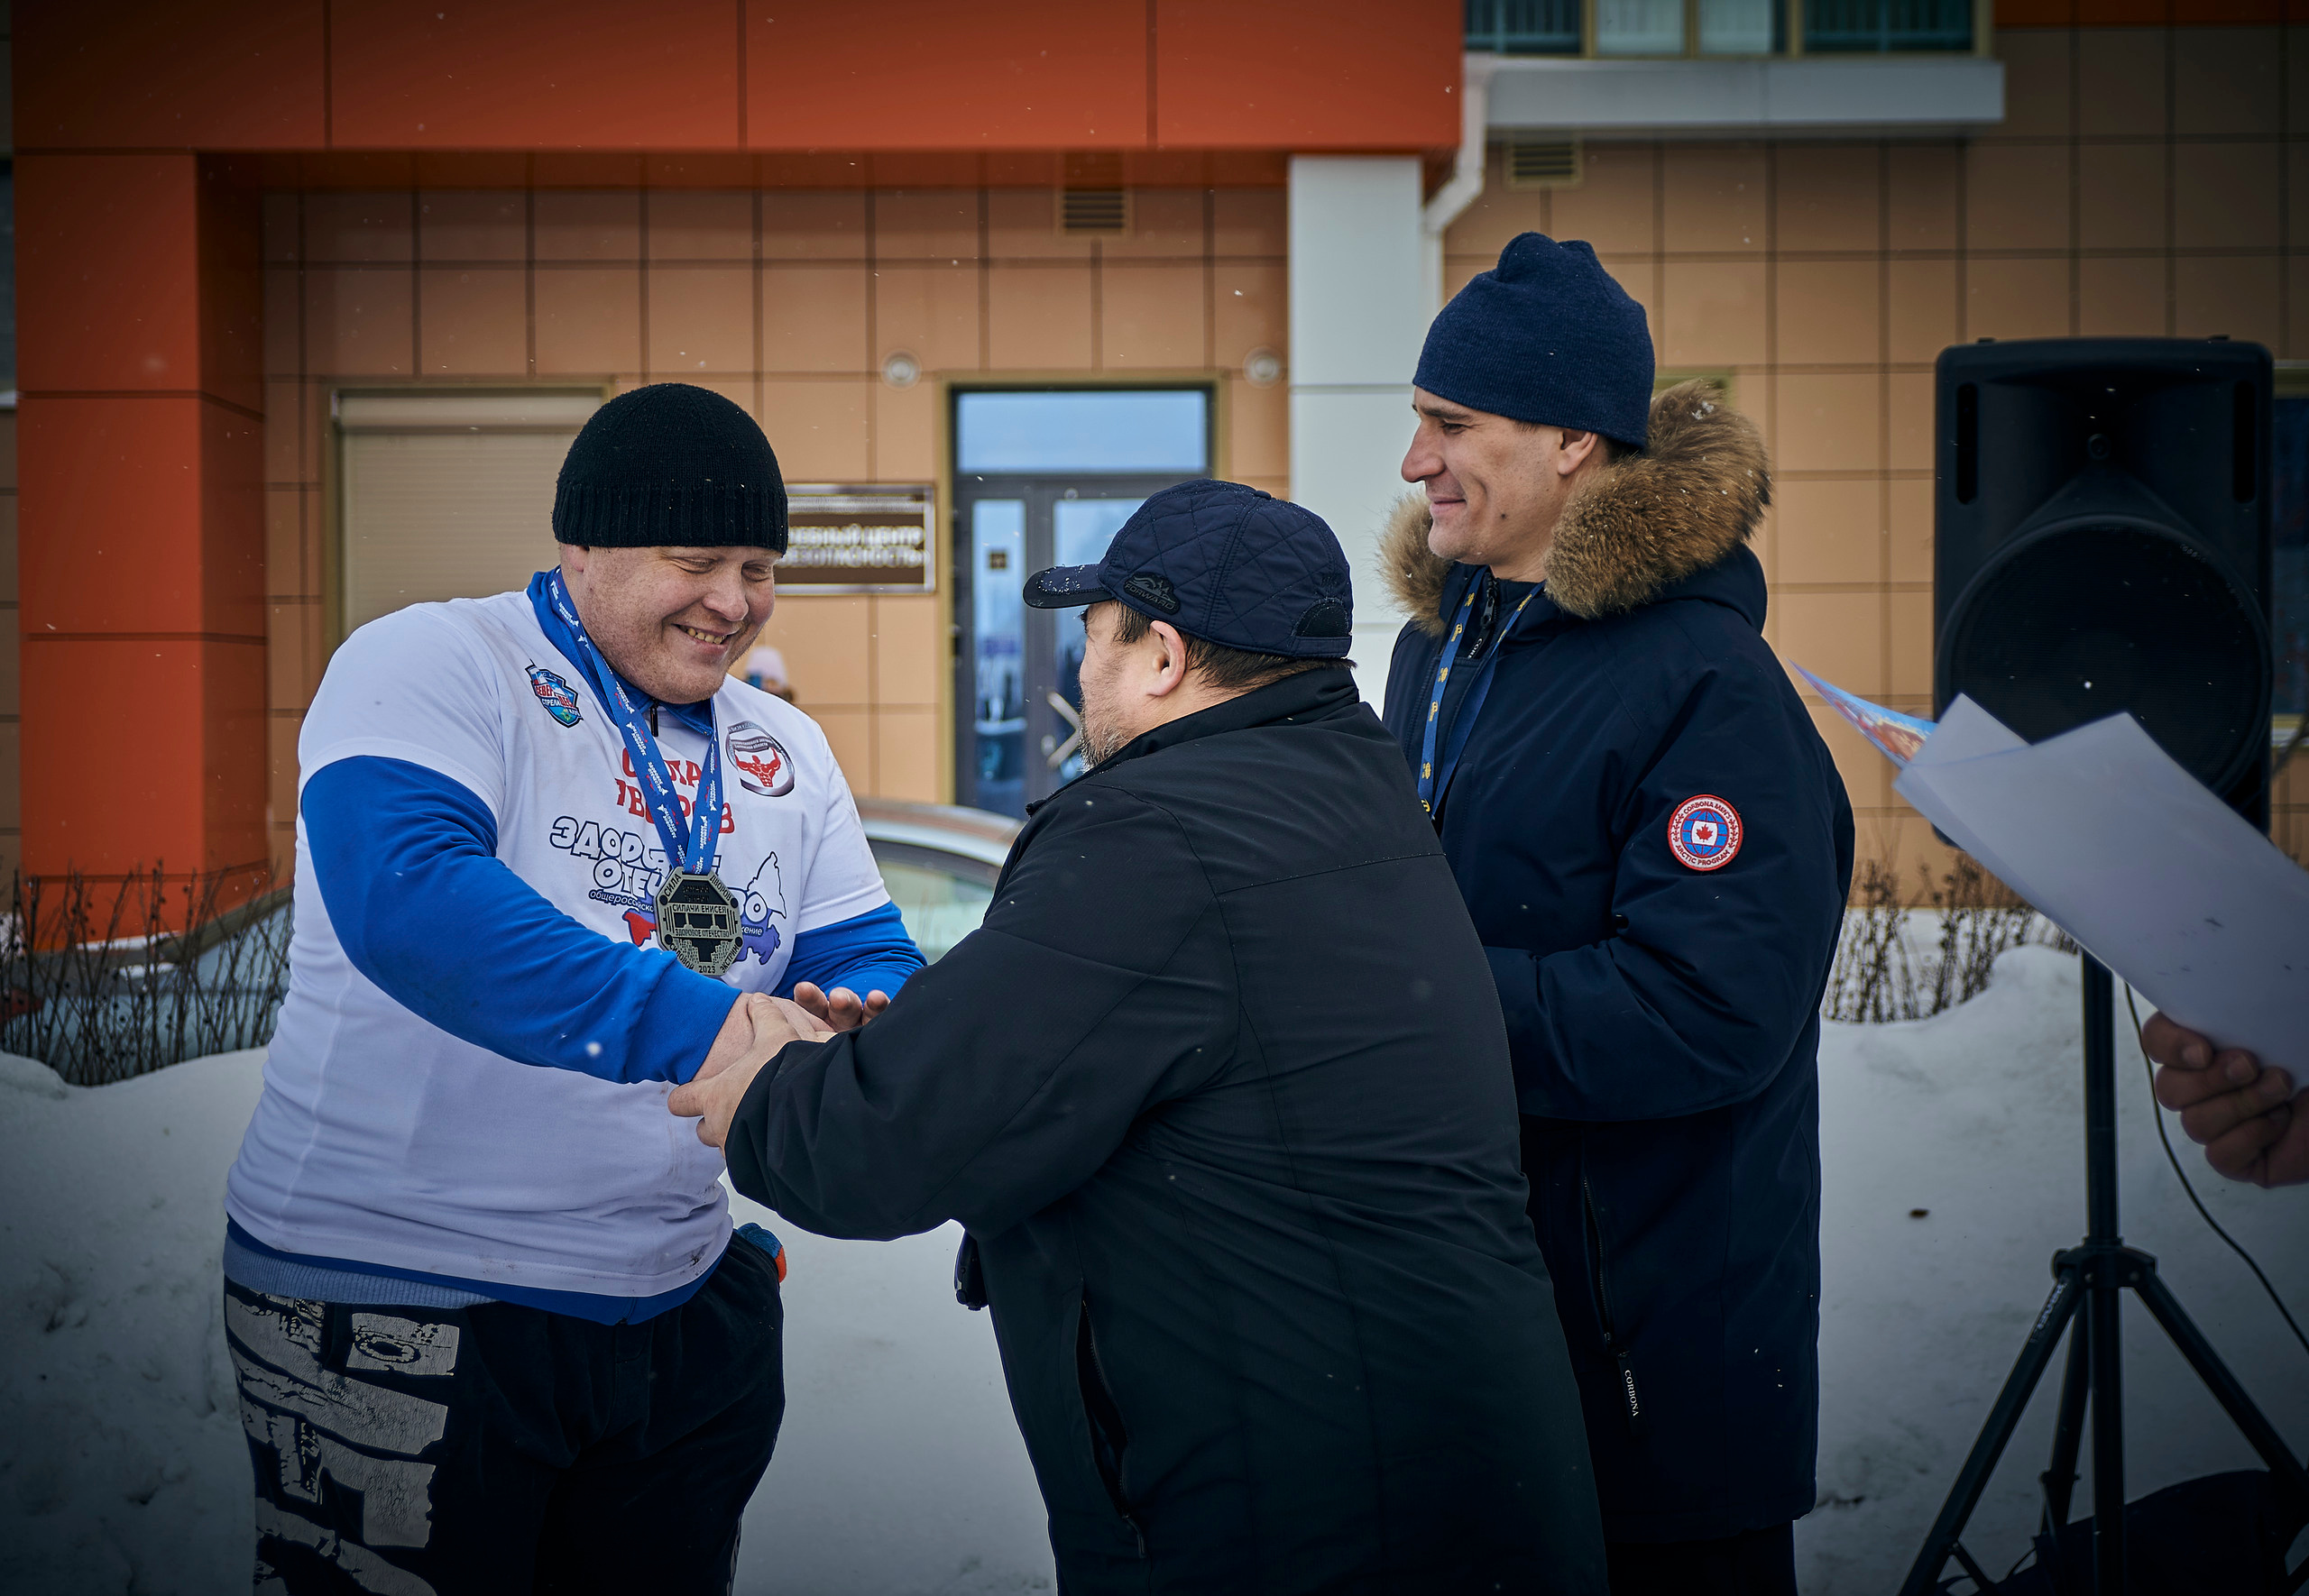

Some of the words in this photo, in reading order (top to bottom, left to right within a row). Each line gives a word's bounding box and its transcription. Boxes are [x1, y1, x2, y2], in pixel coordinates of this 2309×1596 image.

[1125, 583, 1175, 610] FORWARD
[1683, 801, 1714, 814] CORBONA
[1676, 845, 1697, 864] ARCTIC
[1697, 849, 1731, 866] PROGRAM
[663, 873, 682, 897] СИЛА
[672, 903, 700, 913] СИЛАЧИ
[701, 904, 727, 914] ЕНИСЕЯ
[675, 928, 702, 937] ЗДОРОВОЕ
[702, 929, 730, 938] ОТЕЧЕСТВО
[698, 965, 716, 974] 2023
[720, 943, 740, 974] ЭКСТРИМ
[1624, 1370, 1640, 1417] CORBONA
